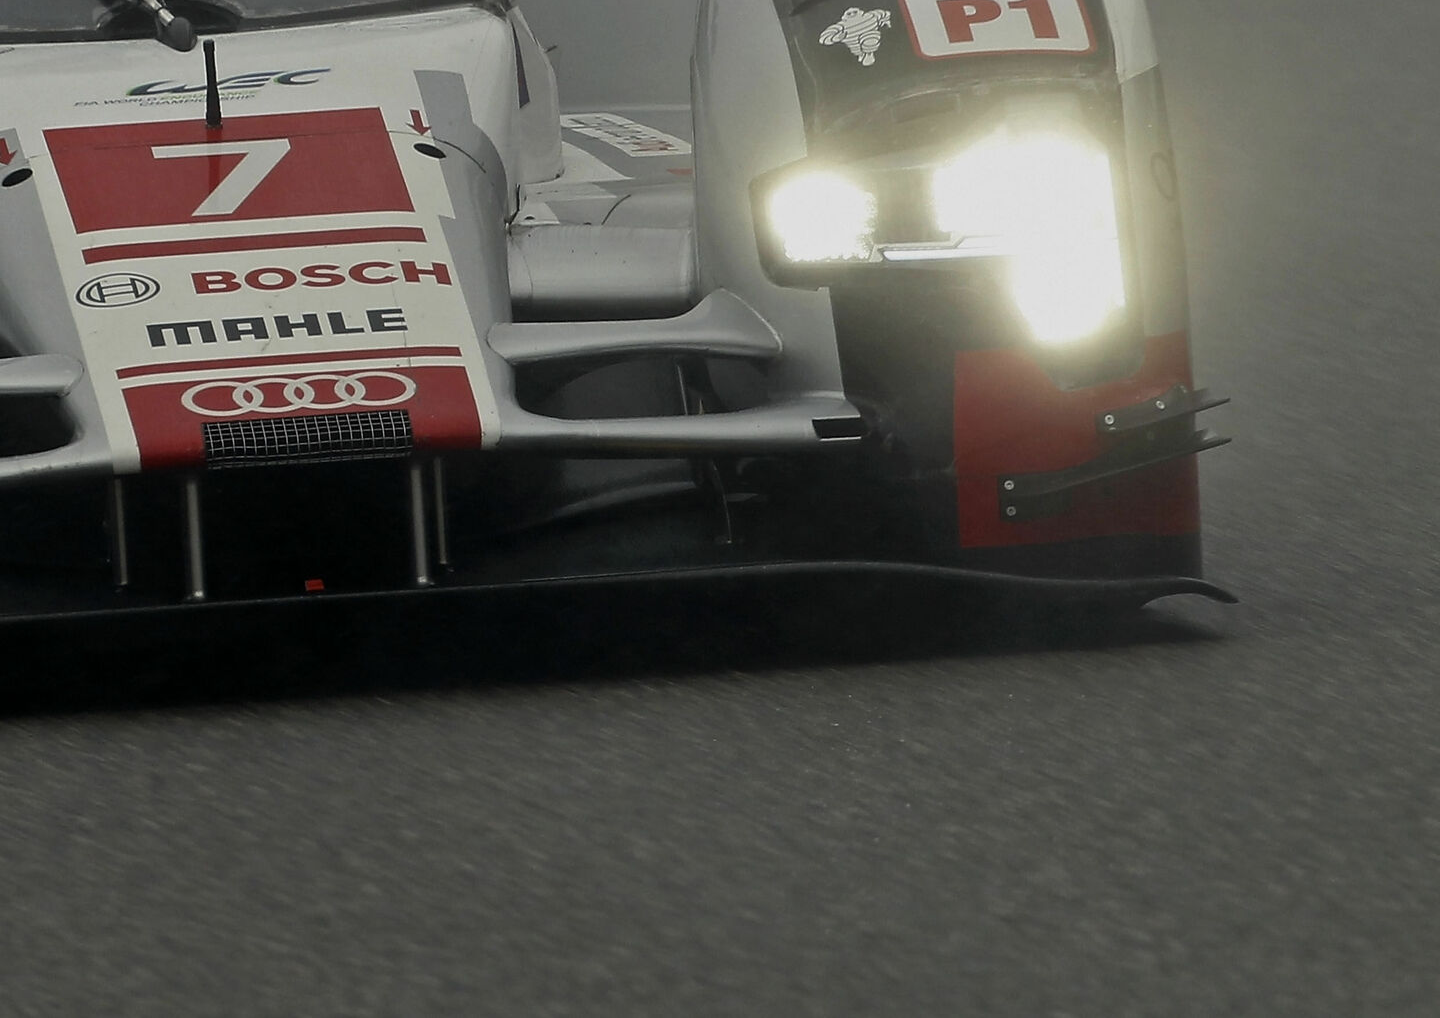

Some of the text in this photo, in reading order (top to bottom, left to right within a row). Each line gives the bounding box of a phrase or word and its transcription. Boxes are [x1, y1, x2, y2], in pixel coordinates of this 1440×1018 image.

[103, 96, 158, 105] WORLD
[151, 138, 291, 217] 7
[191, 260, 453, 295] BOSCH
[146, 307, 409, 348] MAHLE
